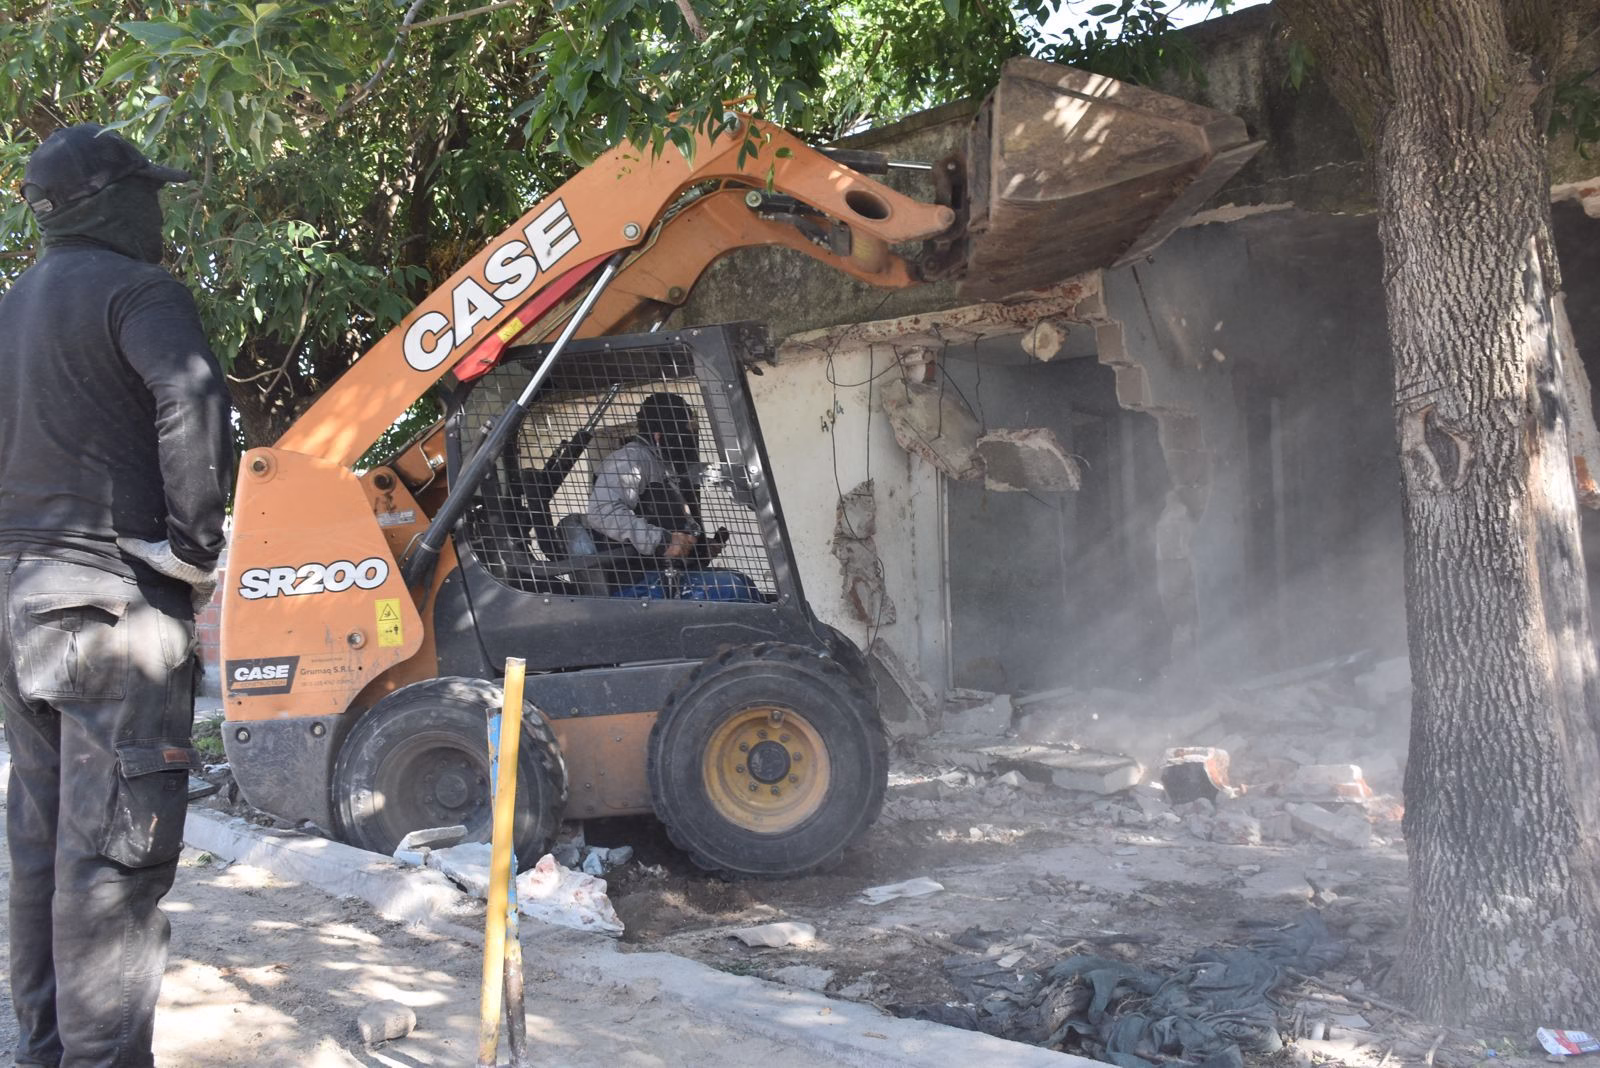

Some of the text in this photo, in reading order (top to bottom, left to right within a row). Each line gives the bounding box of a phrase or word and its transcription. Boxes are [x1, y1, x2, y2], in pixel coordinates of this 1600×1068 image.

[403, 197, 581, 372] CASE
[238, 557, 389, 600] SR200
[234, 664, 290, 681] CASE
